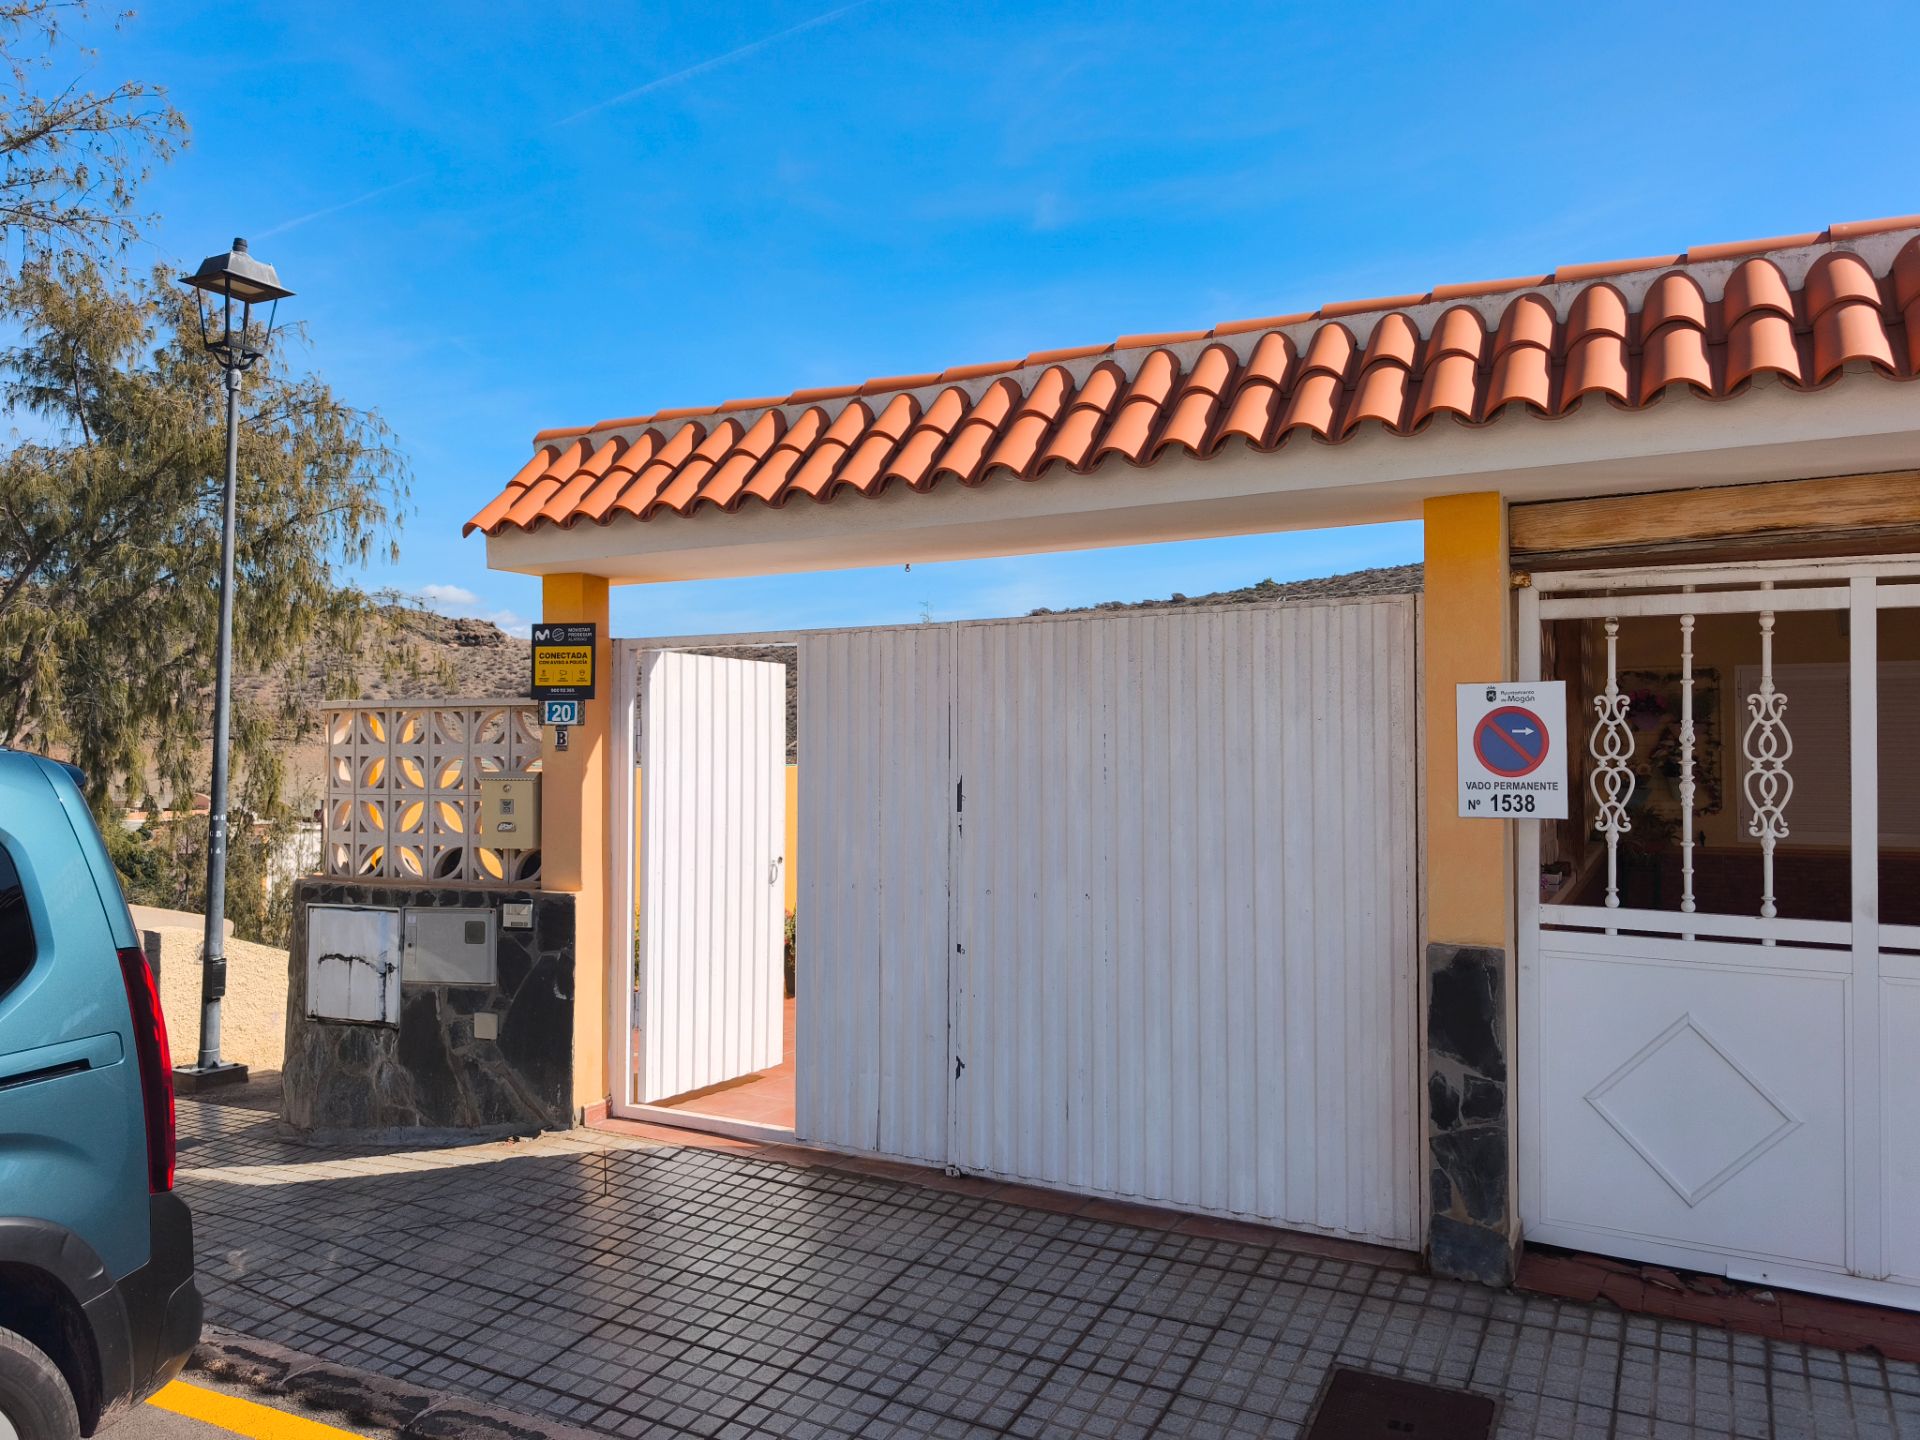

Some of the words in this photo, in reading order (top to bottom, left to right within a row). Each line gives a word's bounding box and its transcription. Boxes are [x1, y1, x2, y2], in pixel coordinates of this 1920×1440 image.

[552, 704, 571, 722] 20
[557, 732, 566, 744] B
[1466, 782, 1491, 790] VADO
[1494, 782, 1558, 790] PERMANENTE
[1468, 800, 1480, 810] Nº
[1490, 794, 1535, 812] 1538
